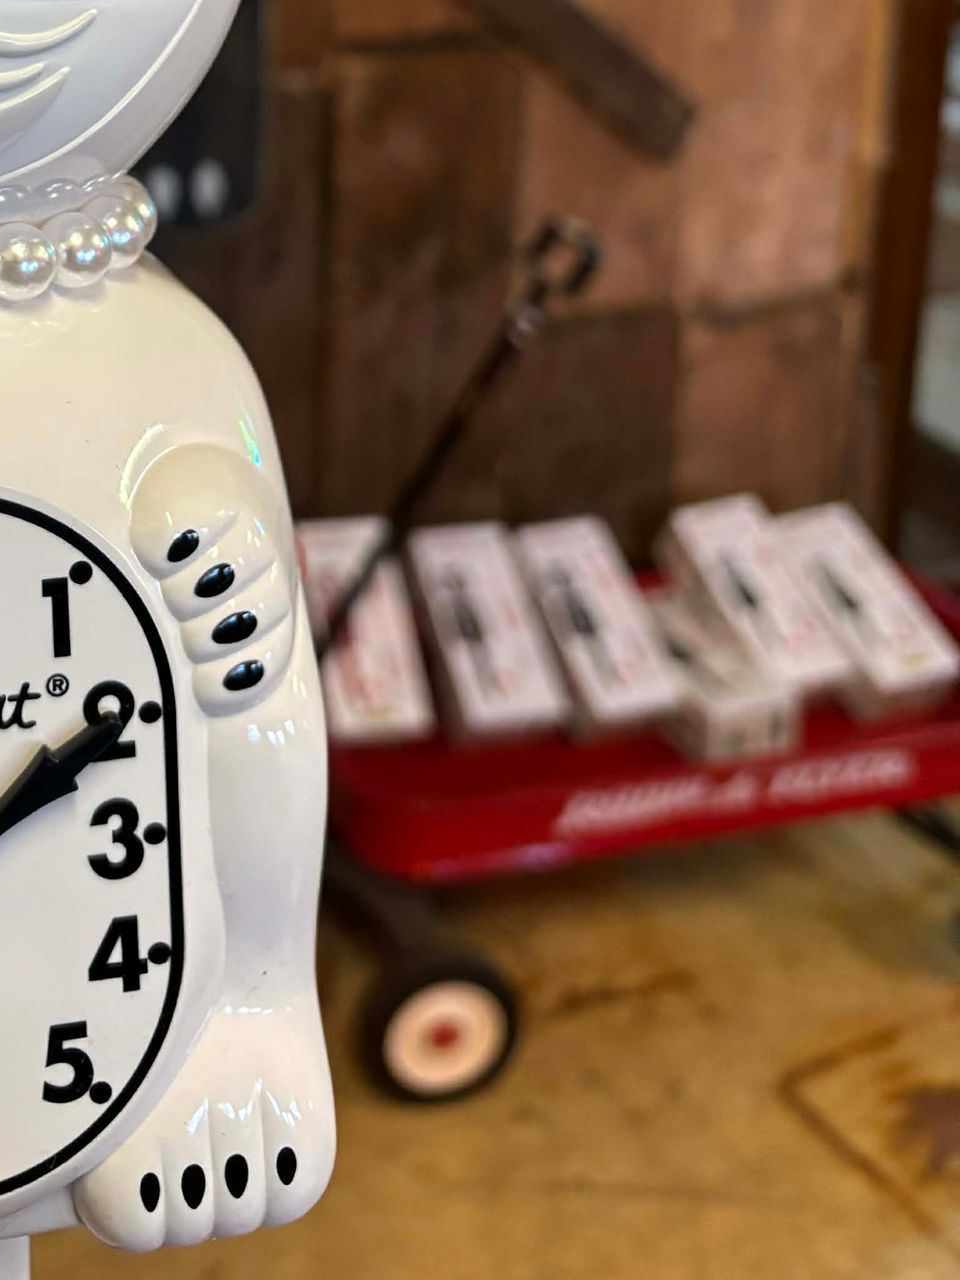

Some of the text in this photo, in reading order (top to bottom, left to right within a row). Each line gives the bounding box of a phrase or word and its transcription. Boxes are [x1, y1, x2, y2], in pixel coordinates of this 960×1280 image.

[42, 577, 71, 658] 1
[83, 681, 135, 762] 2
[88, 798, 142, 880] 3
[88, 915, 148, 992] 4
[42, 1021, 95, 1104] 5
